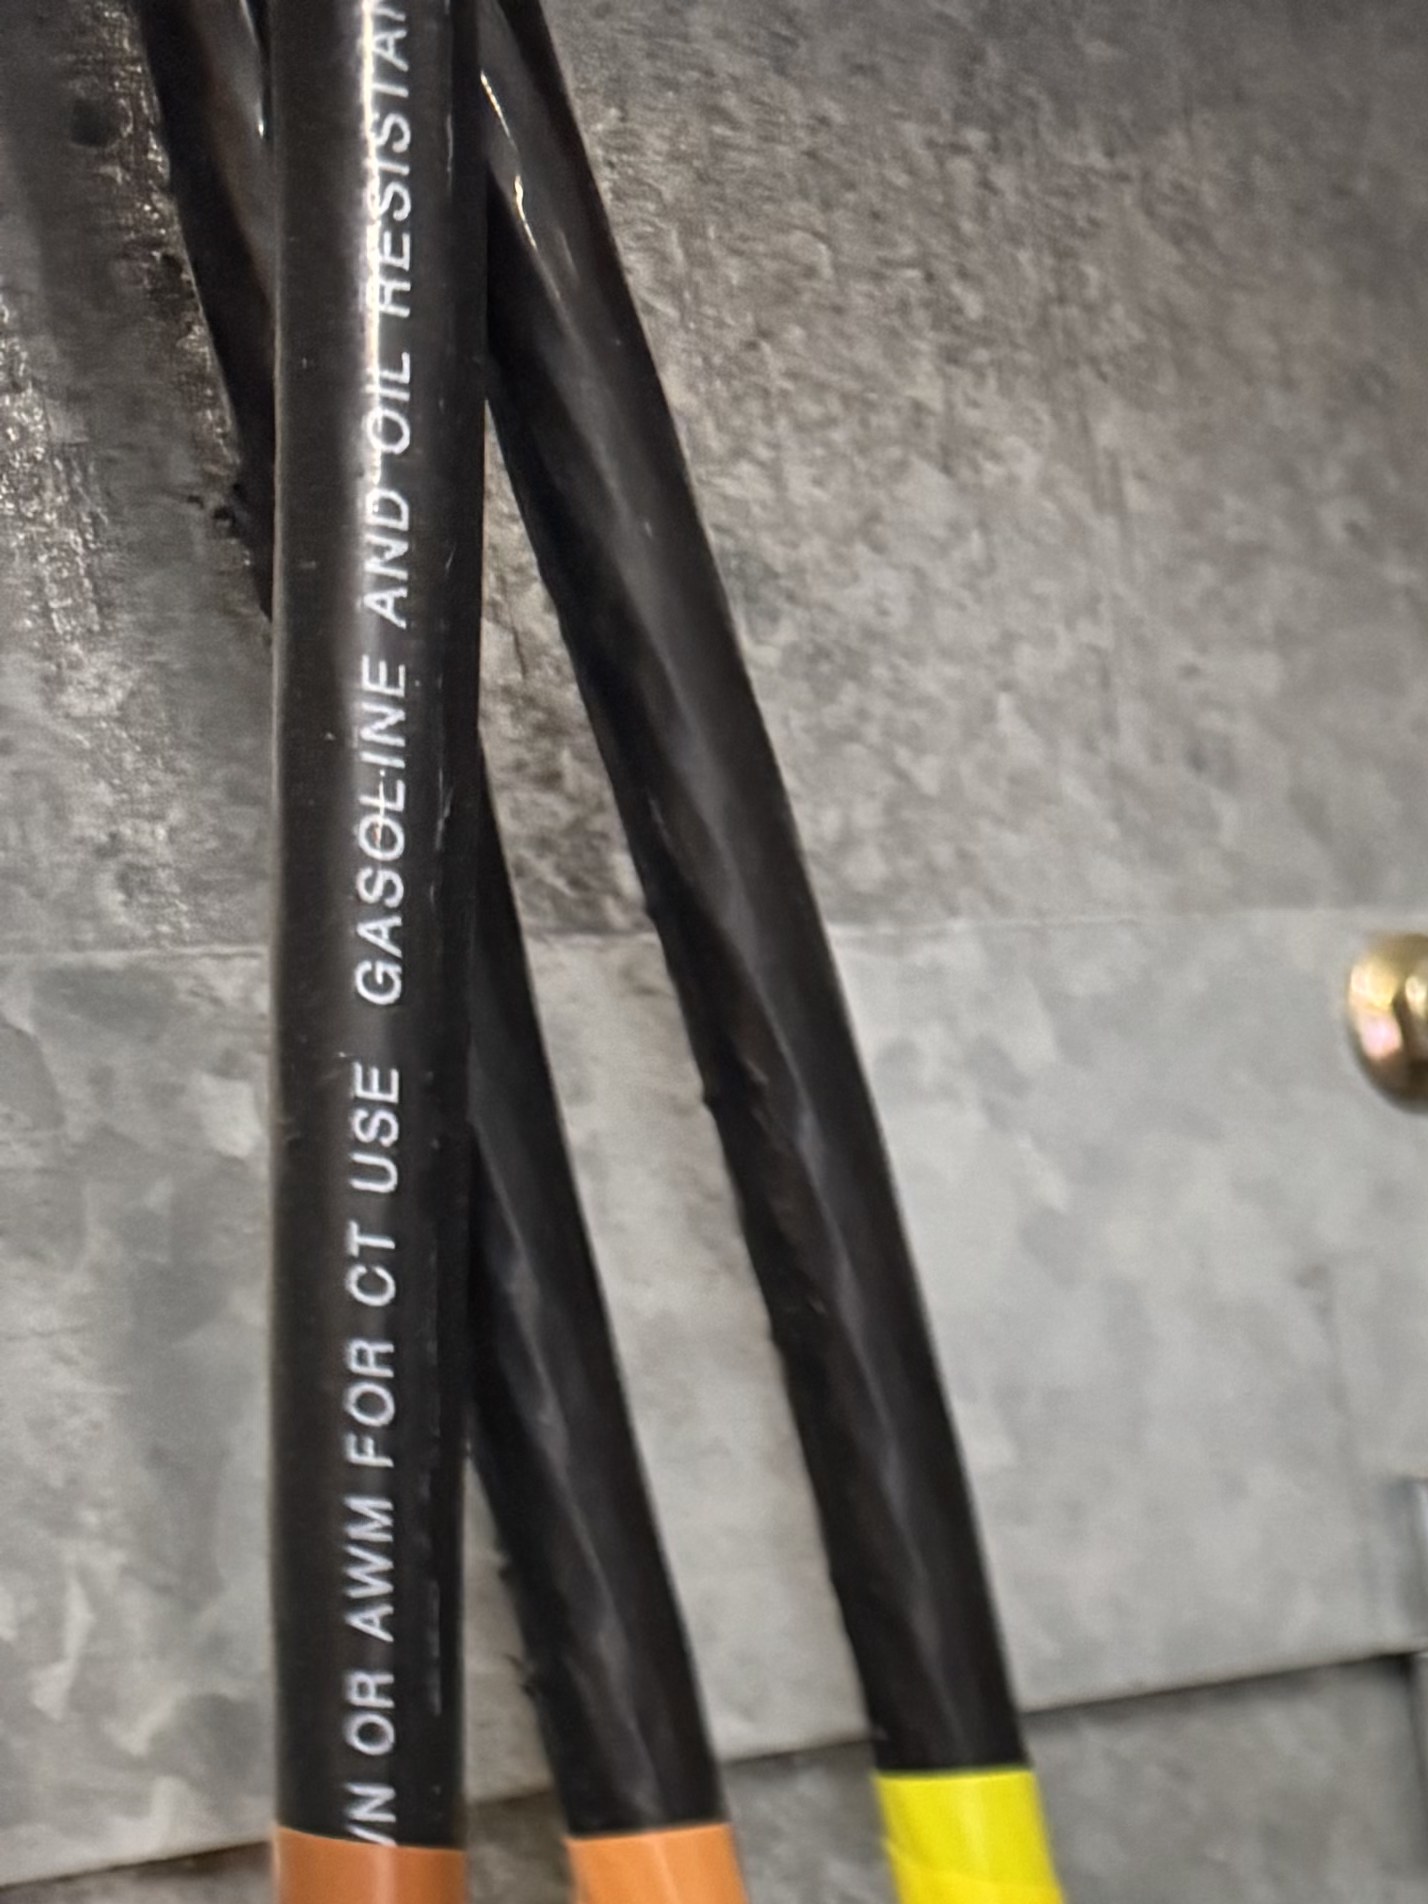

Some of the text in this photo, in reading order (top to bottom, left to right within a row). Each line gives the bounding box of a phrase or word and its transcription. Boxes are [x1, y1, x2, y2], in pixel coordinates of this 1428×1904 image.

[365, 352, 411, 455] OIL
[362, 488, 410, 628] AND
[354, 653, 406, 1006] GASOLINE
[350, 1062, 400, 1194] USE
[345, 1220, 397, 1306] CT
[344, 1338, 396, 1467] FOR
[344, 1497, 395, 1643] AWM
[344, 1670, 395, 1756] OR
